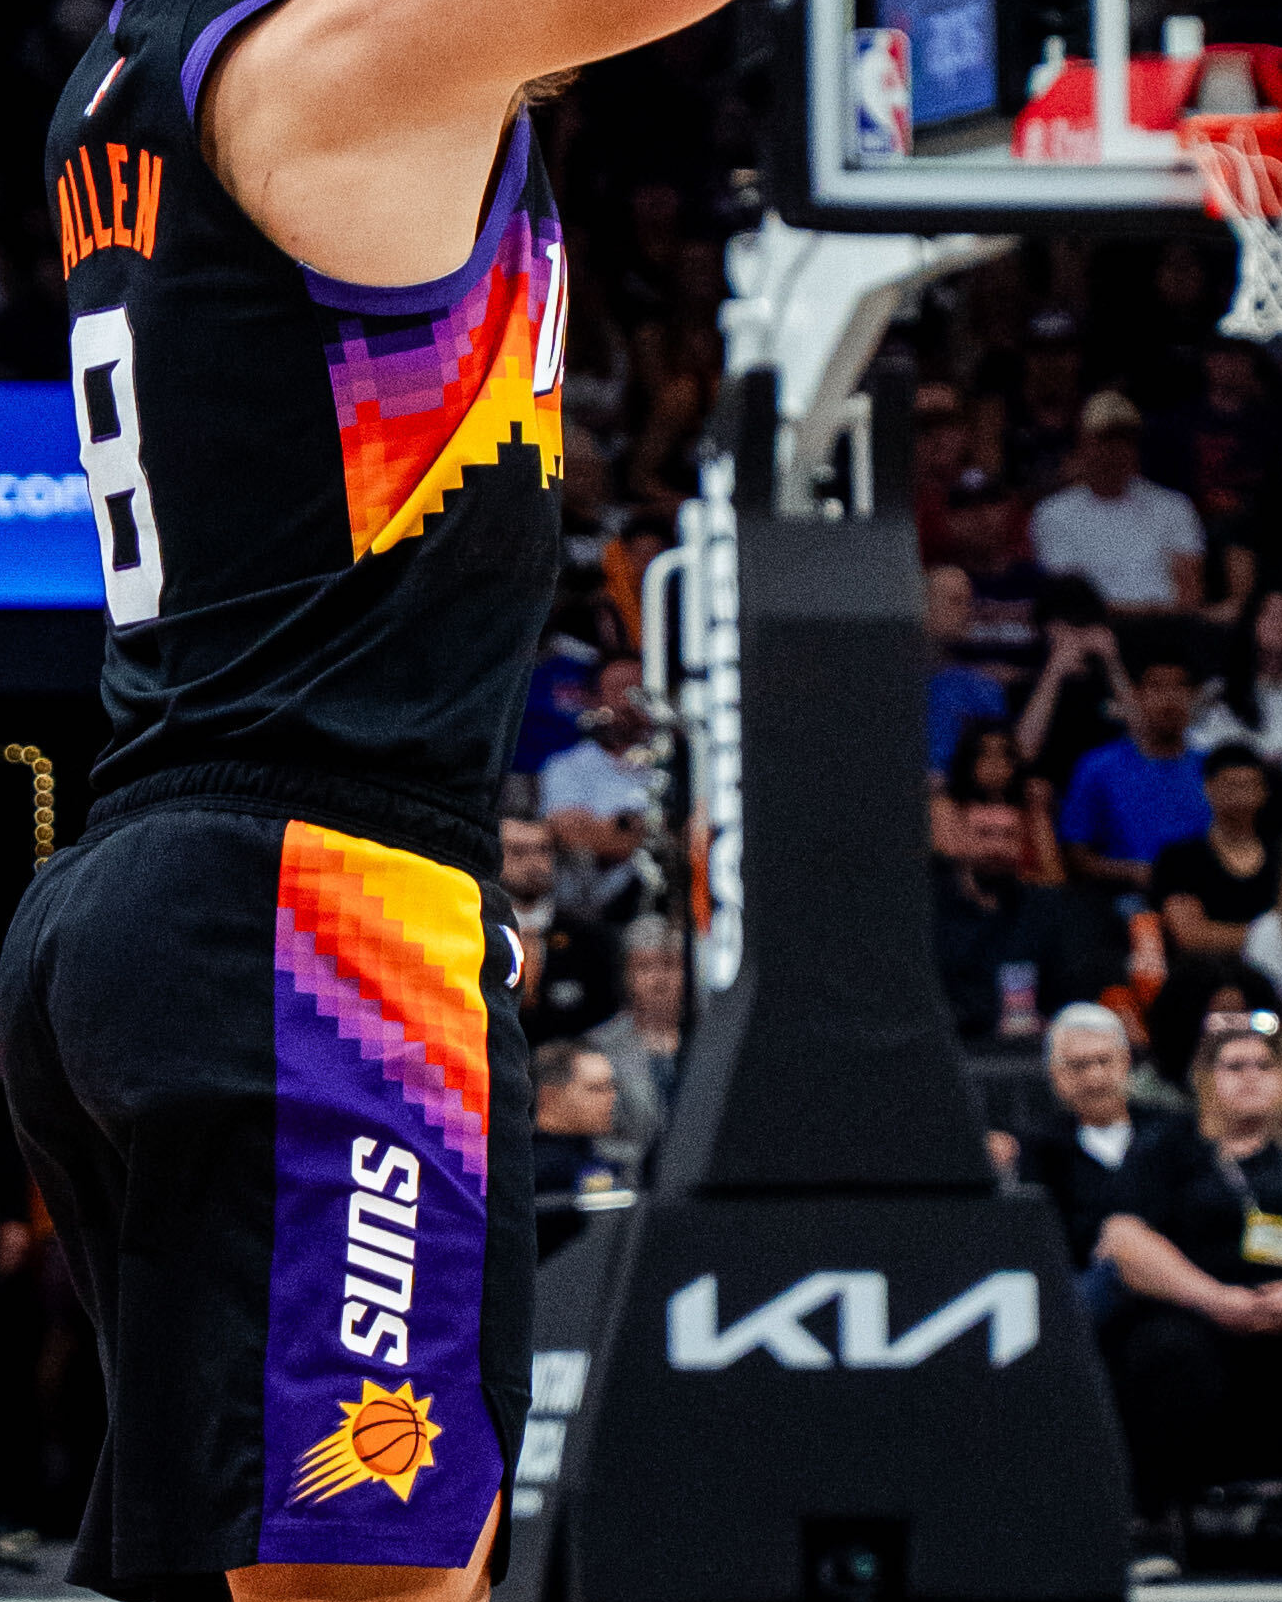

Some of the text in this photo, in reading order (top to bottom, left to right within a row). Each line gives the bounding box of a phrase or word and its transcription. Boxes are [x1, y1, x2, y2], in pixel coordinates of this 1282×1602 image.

[58, 142, 164, 281] ALLEN
[70, 302, 166, 627] 8
[340, 1135, 421, 1367] SUNS
[667, 1271, 1040, 1369] KIA
